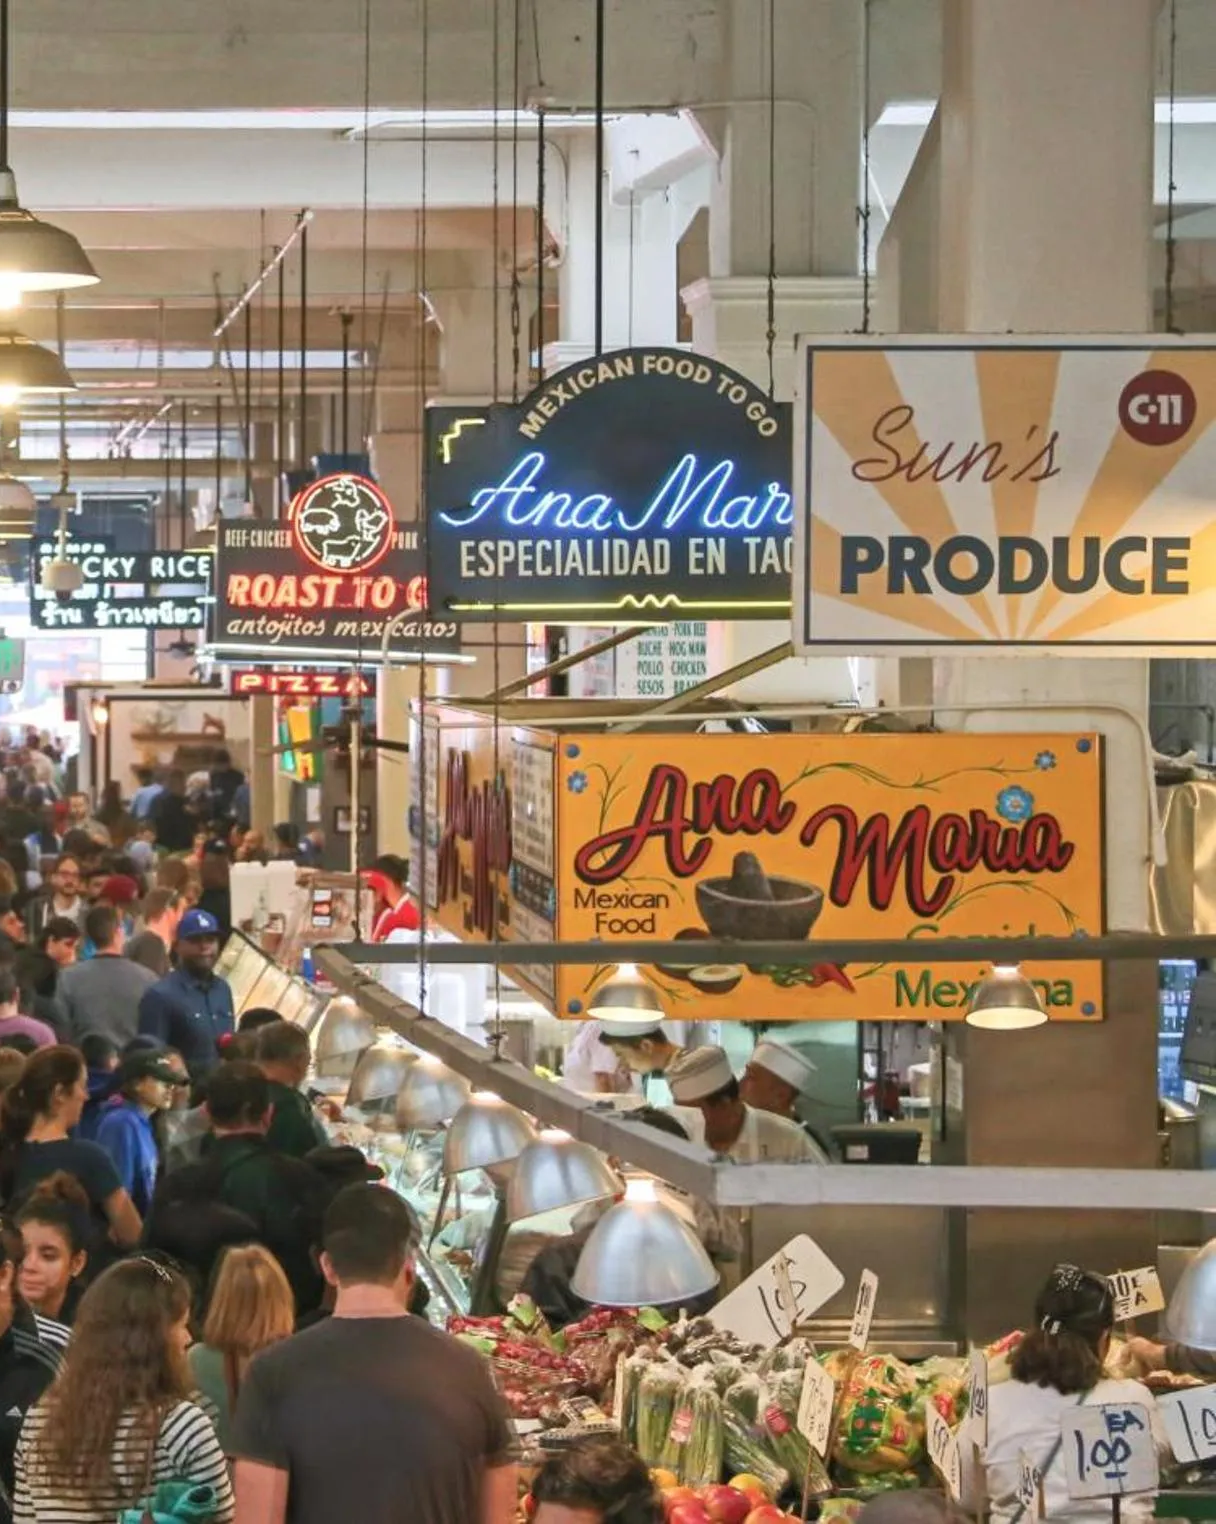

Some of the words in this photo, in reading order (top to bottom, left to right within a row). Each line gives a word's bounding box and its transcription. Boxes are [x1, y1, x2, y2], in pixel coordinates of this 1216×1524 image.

[518, 355, 634, 441] MEXICAN
[642, 354, 712, 386] FOOD
[717, 372, 750, 404] TO
[744, 402, 779, 438] GO
[852, 405, 1061, 484] Sun's
[439, 452, 617, 531] Ana
[151, 556, 211, 578] RICE
[460, 537, 670, 578] ESPECIALIDAD
[689, 536, 726, 575] EN
[840, 535, 1191, 595] PRODUCE
[228, 573, 343, 608] ROAST
[352, 576, 396, 608] TO
[239, 674, 368, 692] PIZZA
[574, 764, 797, 885] Ana
[801, 804, 1075, 919] Maria
[573, 888, 670, 913] Mexican
[595, 912, 656, 935] Food
[895, 969, 1073, 1007] Mexna
[1074, 1430, 1132, 1482] 1.00
